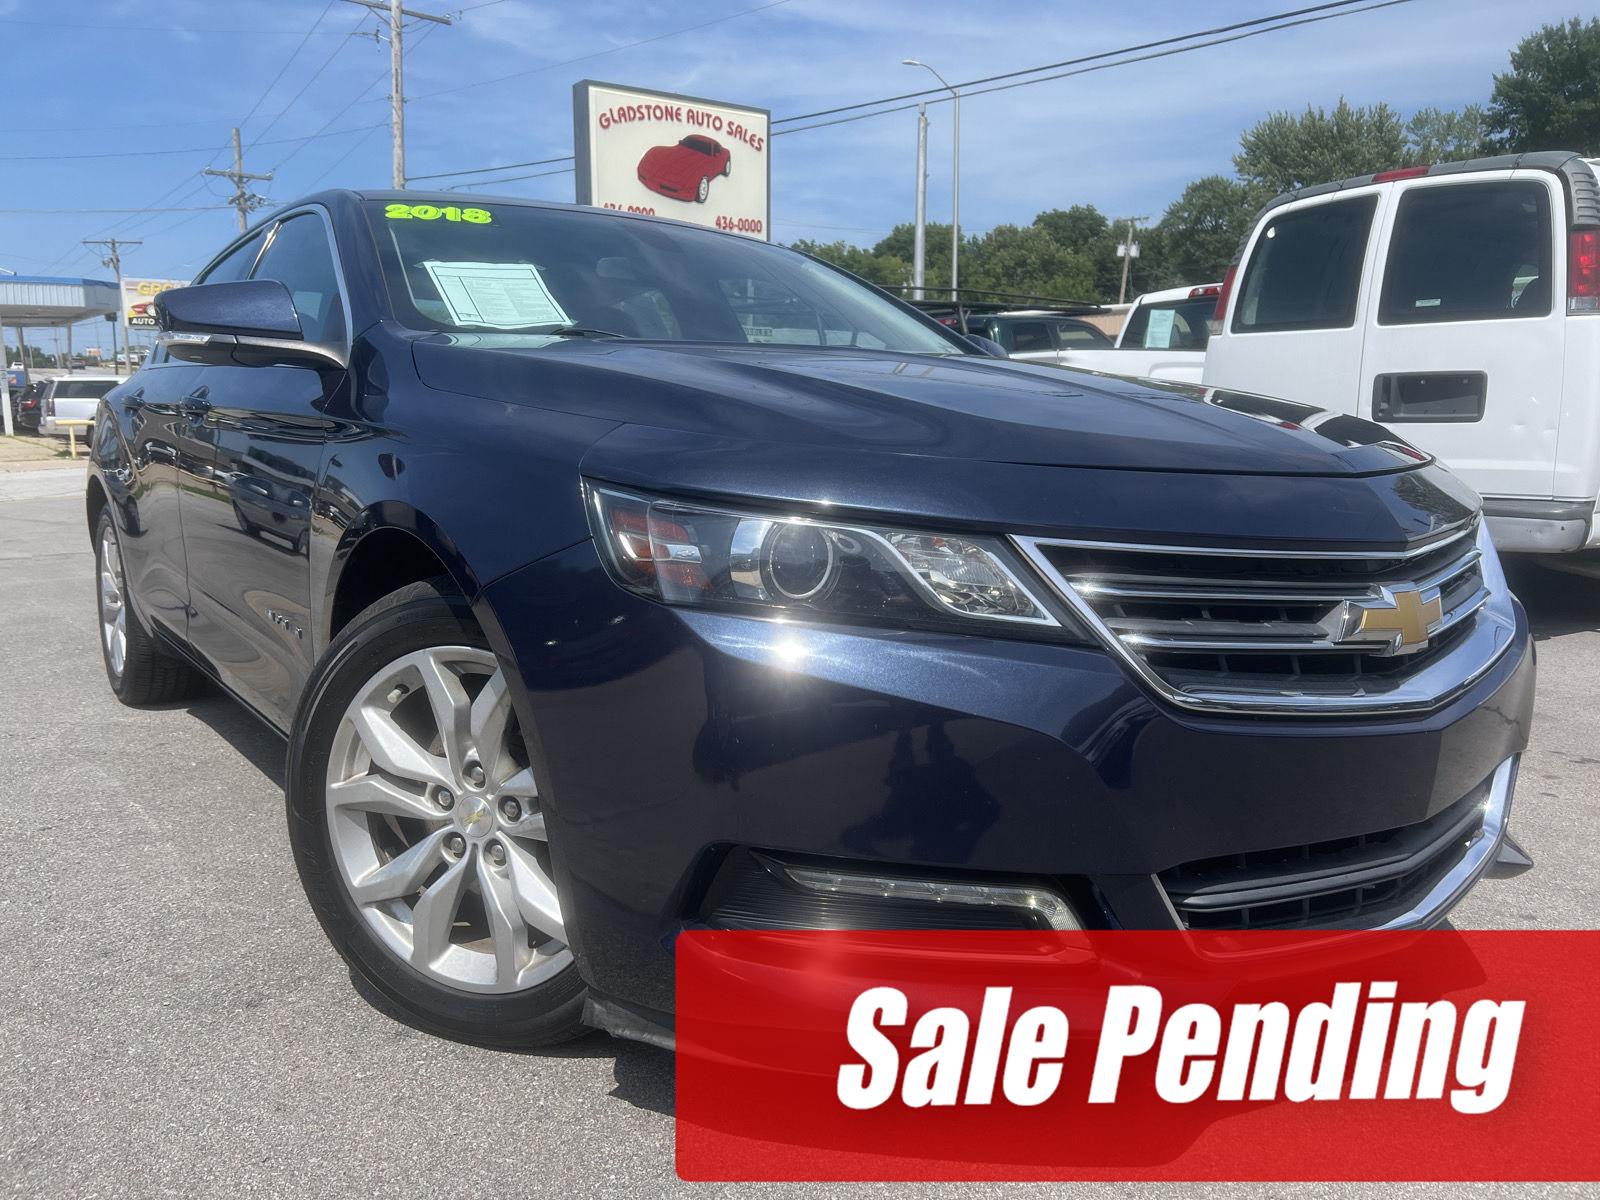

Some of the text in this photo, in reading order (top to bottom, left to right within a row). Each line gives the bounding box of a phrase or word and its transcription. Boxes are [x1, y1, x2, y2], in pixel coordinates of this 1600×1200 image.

[599, 104, 764, 152] GLADSTONE AUTO SALES
[385, 204, 492, 224] 2018
[715, 215, 763, 233] 436-0000
